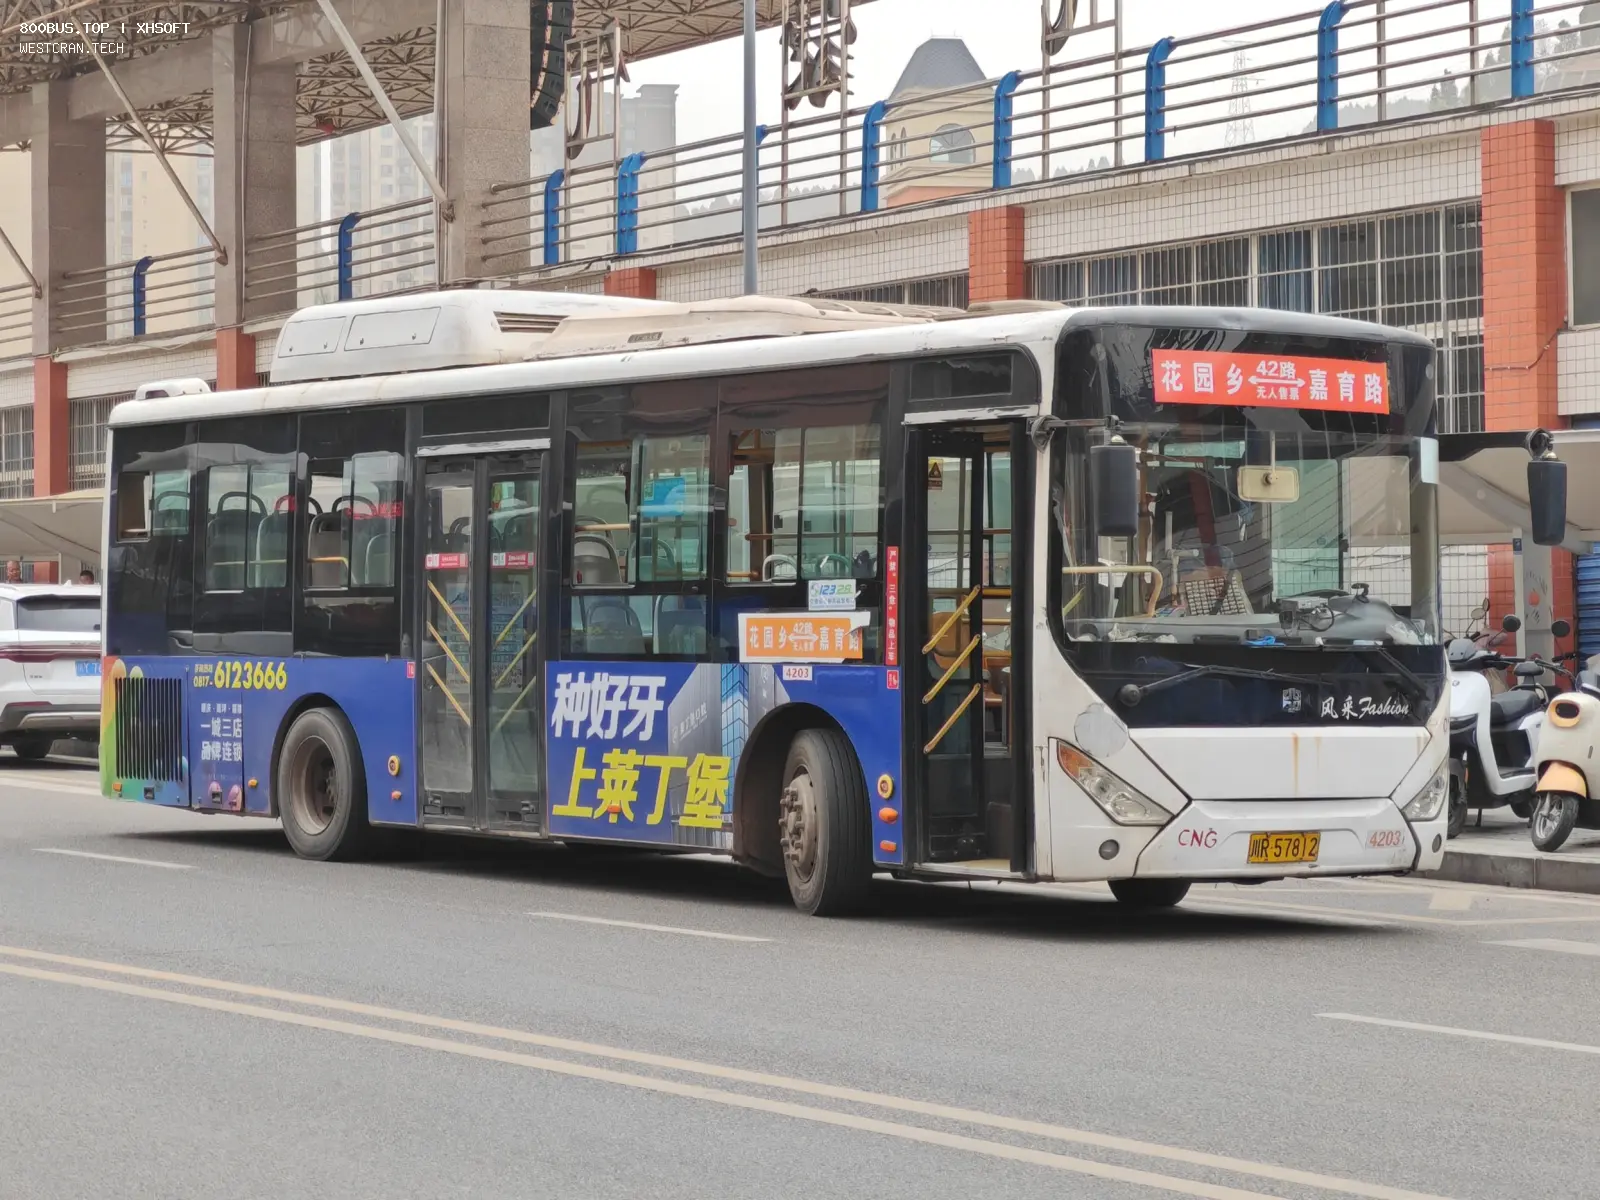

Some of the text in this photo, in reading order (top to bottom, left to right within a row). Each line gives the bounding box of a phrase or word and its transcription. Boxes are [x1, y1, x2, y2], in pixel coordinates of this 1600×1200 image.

[1256, 360, 1297, 379] 42路
[1161, 360, 1383, 405] 花园乡 嘉育路
[1256, 386, 1300, 400] 无人售票
[750, 625, 787, 649] 花园乡
[785, 669, 809, 679] 4203
[551, 672, 666, 741] 种好牙
[1359, 696, 1409, 719] Fashion
[201, 717, 242, 738] 一城三店
[201, 741, 242, 761] 品牌连锁
[552, 747, 731, 828] 上莱丁堡
[1178, 829, 1217, 848] CNG
[1369, 830, 1400, 847] 4203
